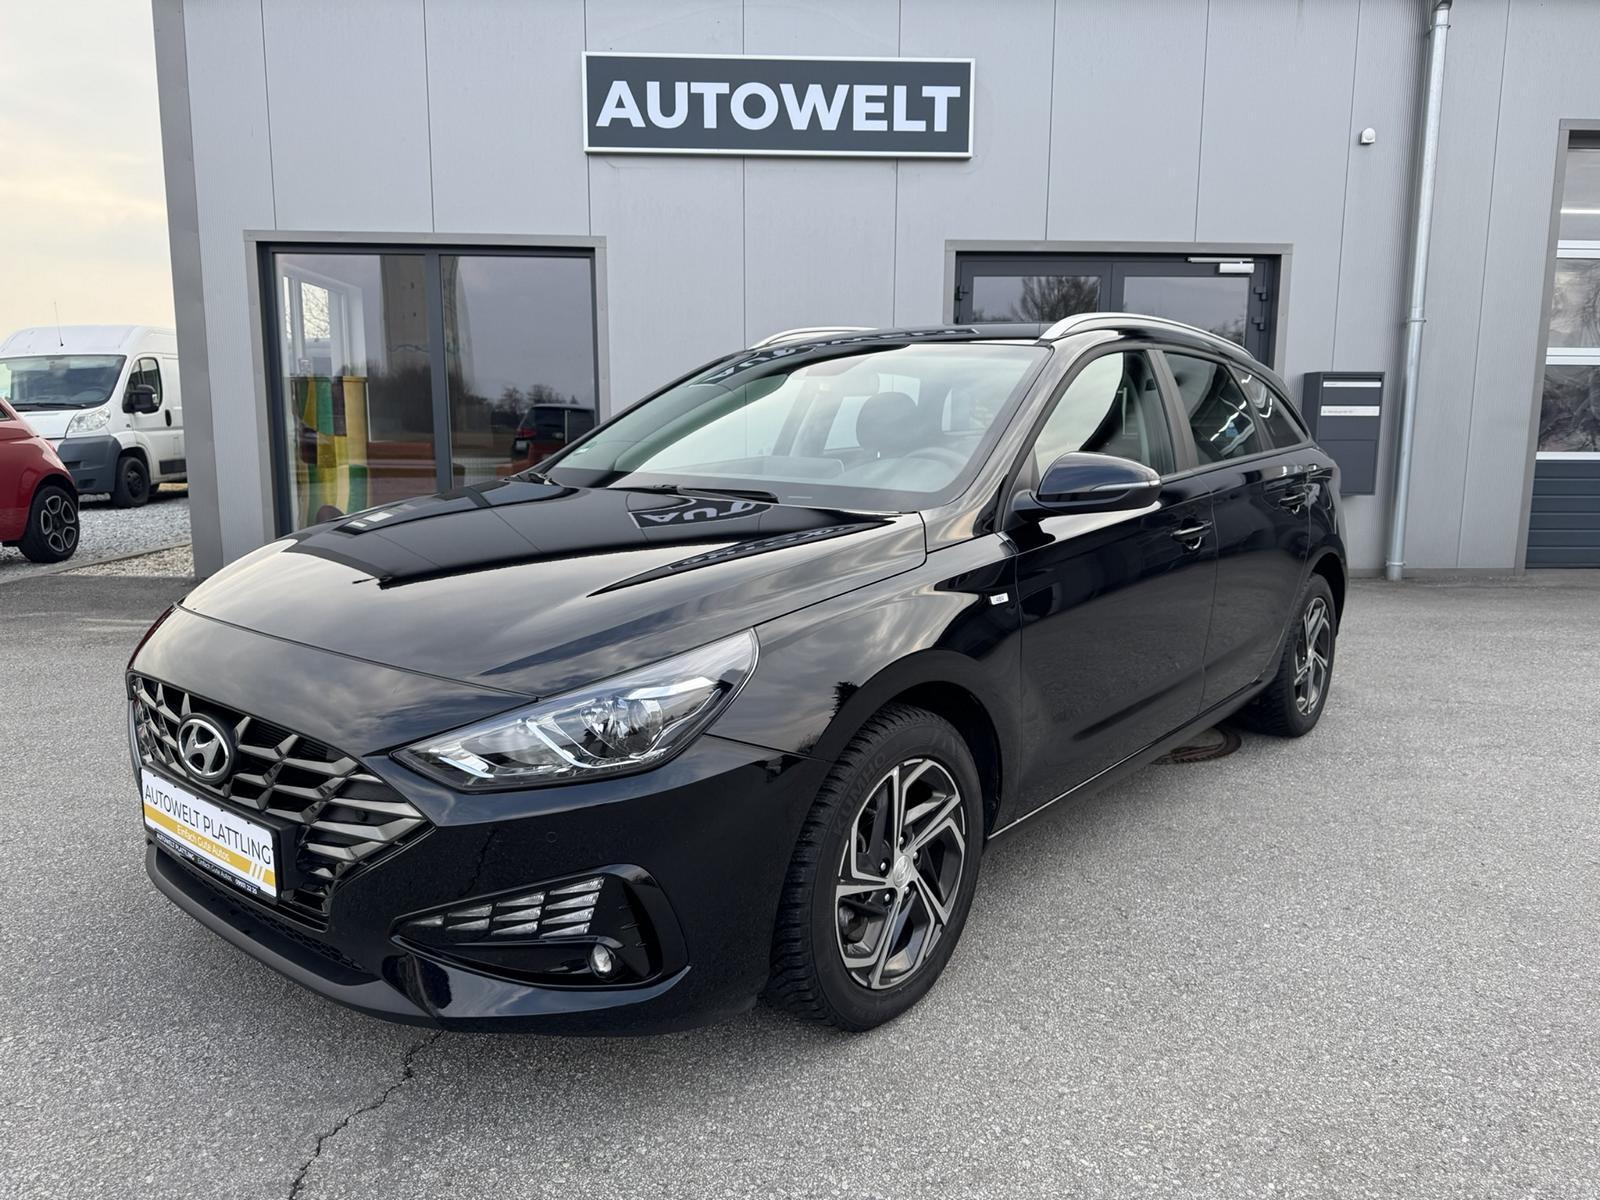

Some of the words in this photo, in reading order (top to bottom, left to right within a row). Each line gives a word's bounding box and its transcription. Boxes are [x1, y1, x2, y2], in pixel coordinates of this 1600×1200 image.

[596, 80, 961, 132] AUTOWELT
[145, 785, 200, 828] AUTOWELT
[203, 815, 271, 864] PLATTLING
[197, 837, 212, 853] Gute
